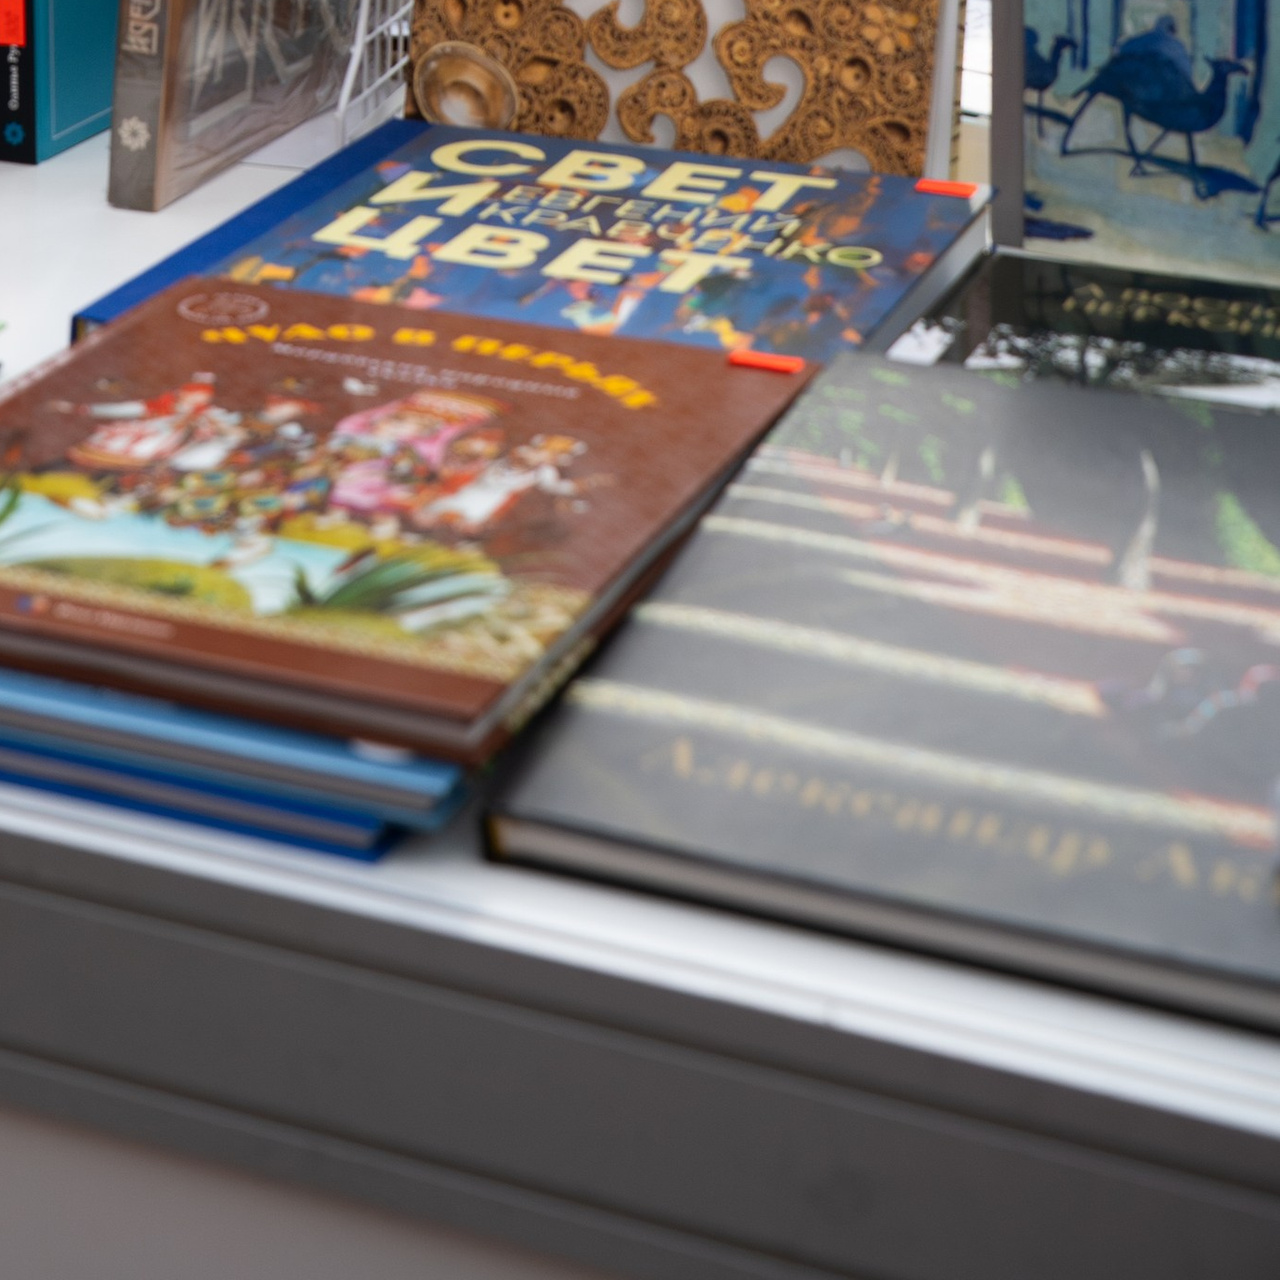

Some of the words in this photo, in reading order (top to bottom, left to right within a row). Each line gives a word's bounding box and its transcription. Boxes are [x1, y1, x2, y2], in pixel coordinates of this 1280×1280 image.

[6, 42, 20, 64] Ру
[368, 169, 501, 218] И
[429, 139, 839, 213] СВЕТ
[477, 201, 884, 270] КРАВЧЕНКО
[502, 184, 803, 239] ЕВГЕНИЙ
[312, 206, 753, 295] ЦВЕТ
